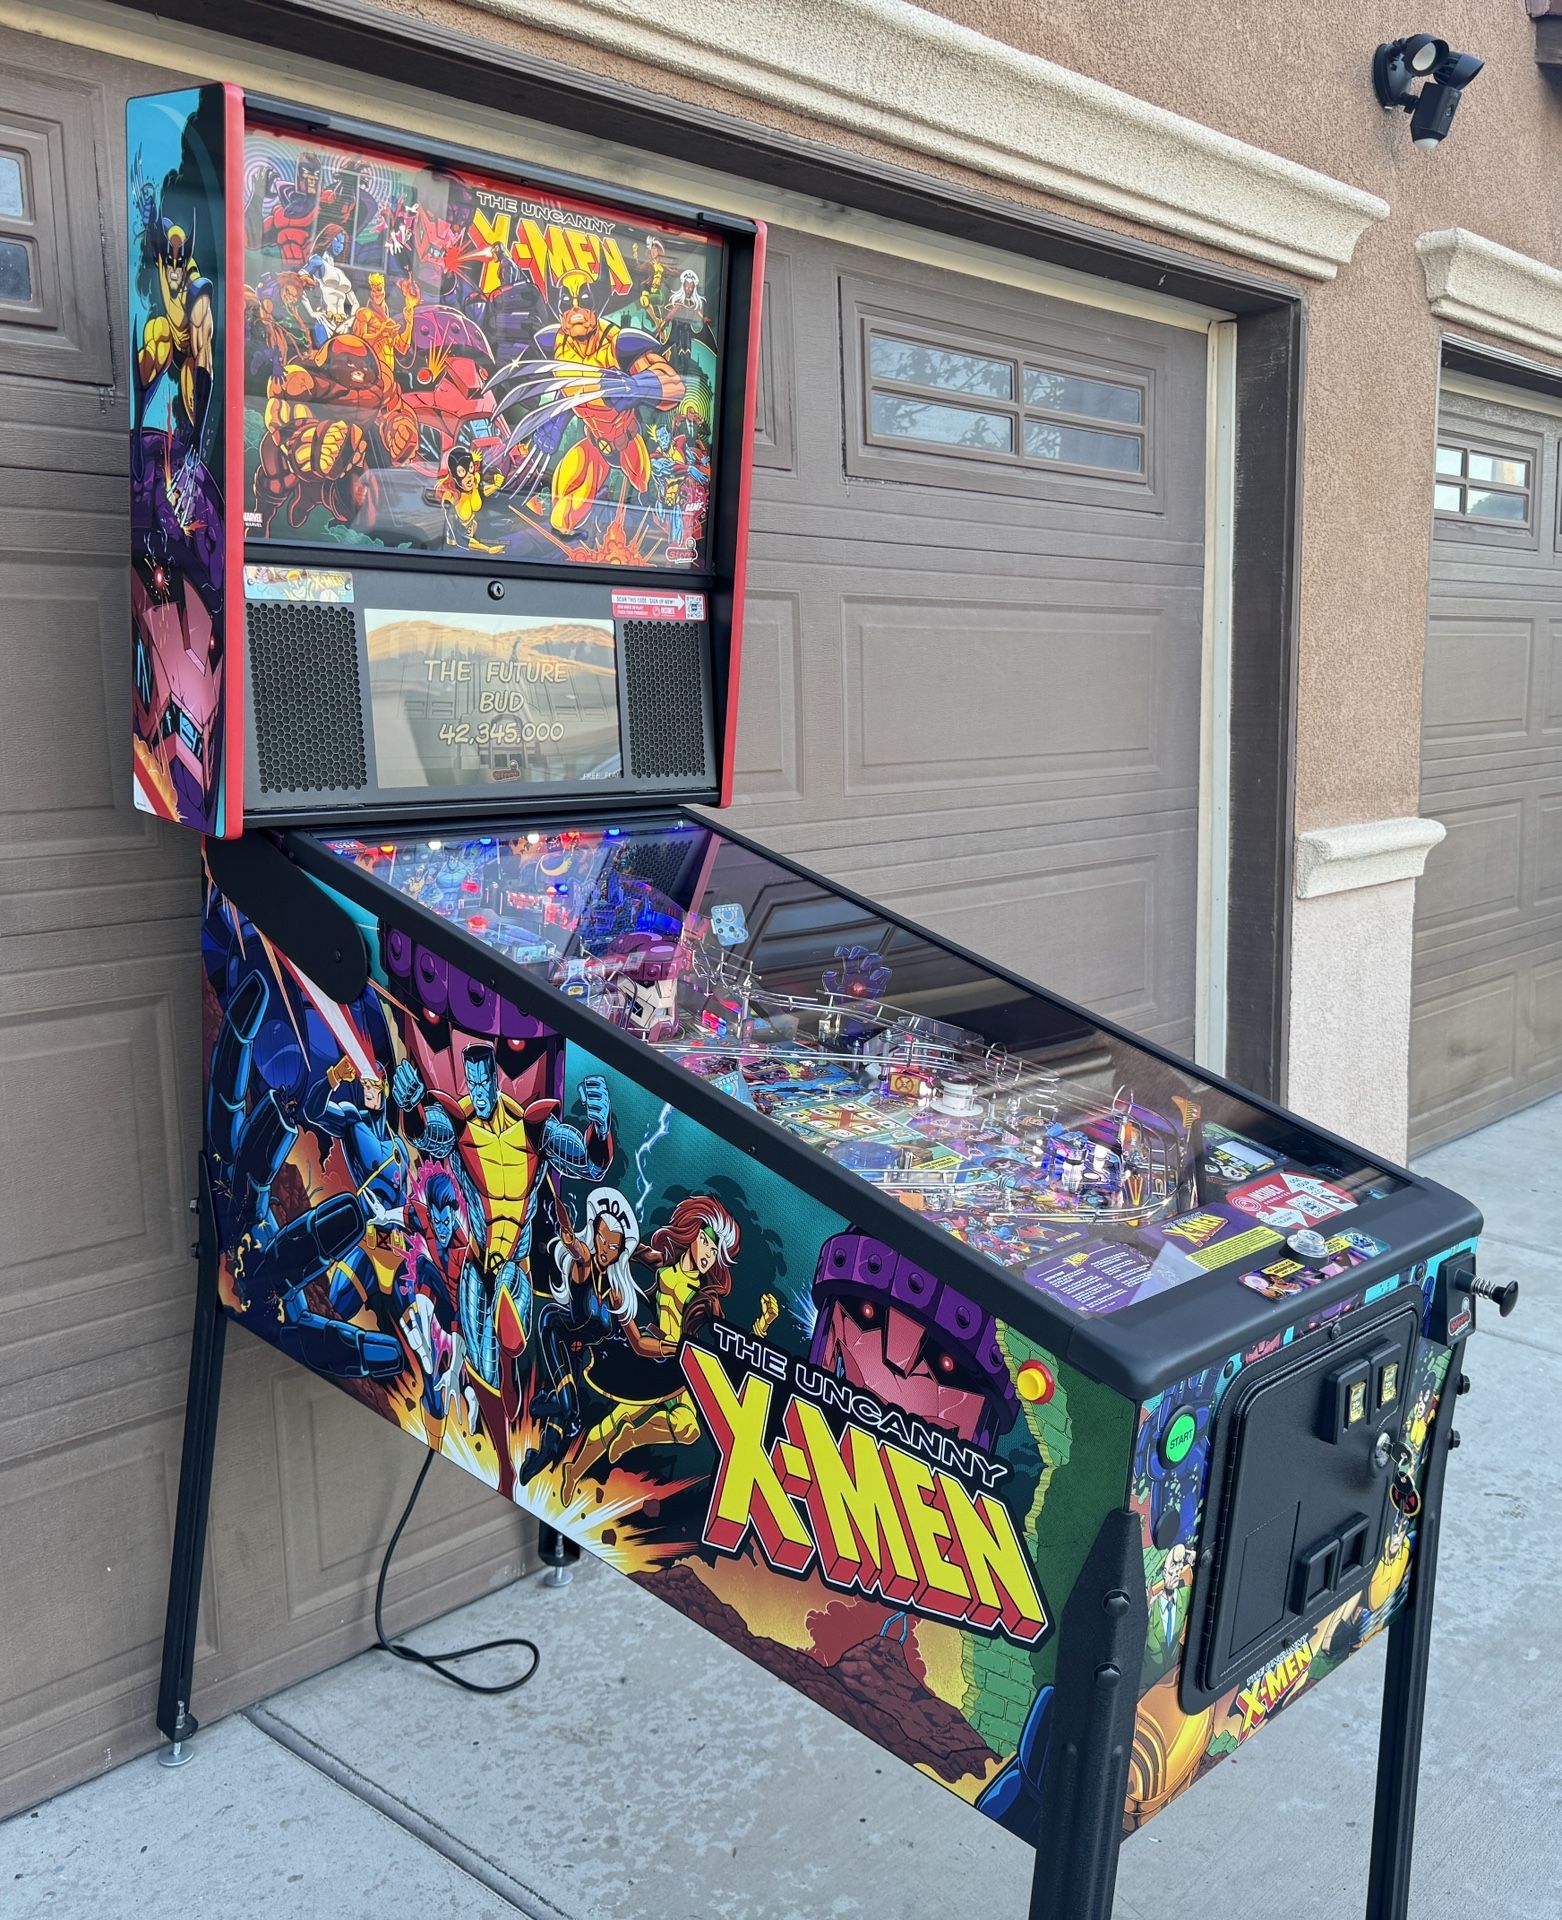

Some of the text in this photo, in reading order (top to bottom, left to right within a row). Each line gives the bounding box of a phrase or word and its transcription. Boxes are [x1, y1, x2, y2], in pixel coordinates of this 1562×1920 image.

[476, 191, 616, 235] THE UNCANNY
[467, 207, 634, 304] X-MEN
[310, 574, 345, 590] X-MEN
[424, 659, 568, 683] THE FUTURE
[479, 691, 524, 712] BUD
[438, 722, 565, 745] 42,345,000
[1161, 1213, 1229, 1248] X-MEN
[713, 1322, 1008, 1489] THE UNCANNY
[1169, 1430, 1194, 1450] START
[680, 1340, 1048, 1644] X-MEN
[1235, 1642, 1313, 1748] X-MEN
